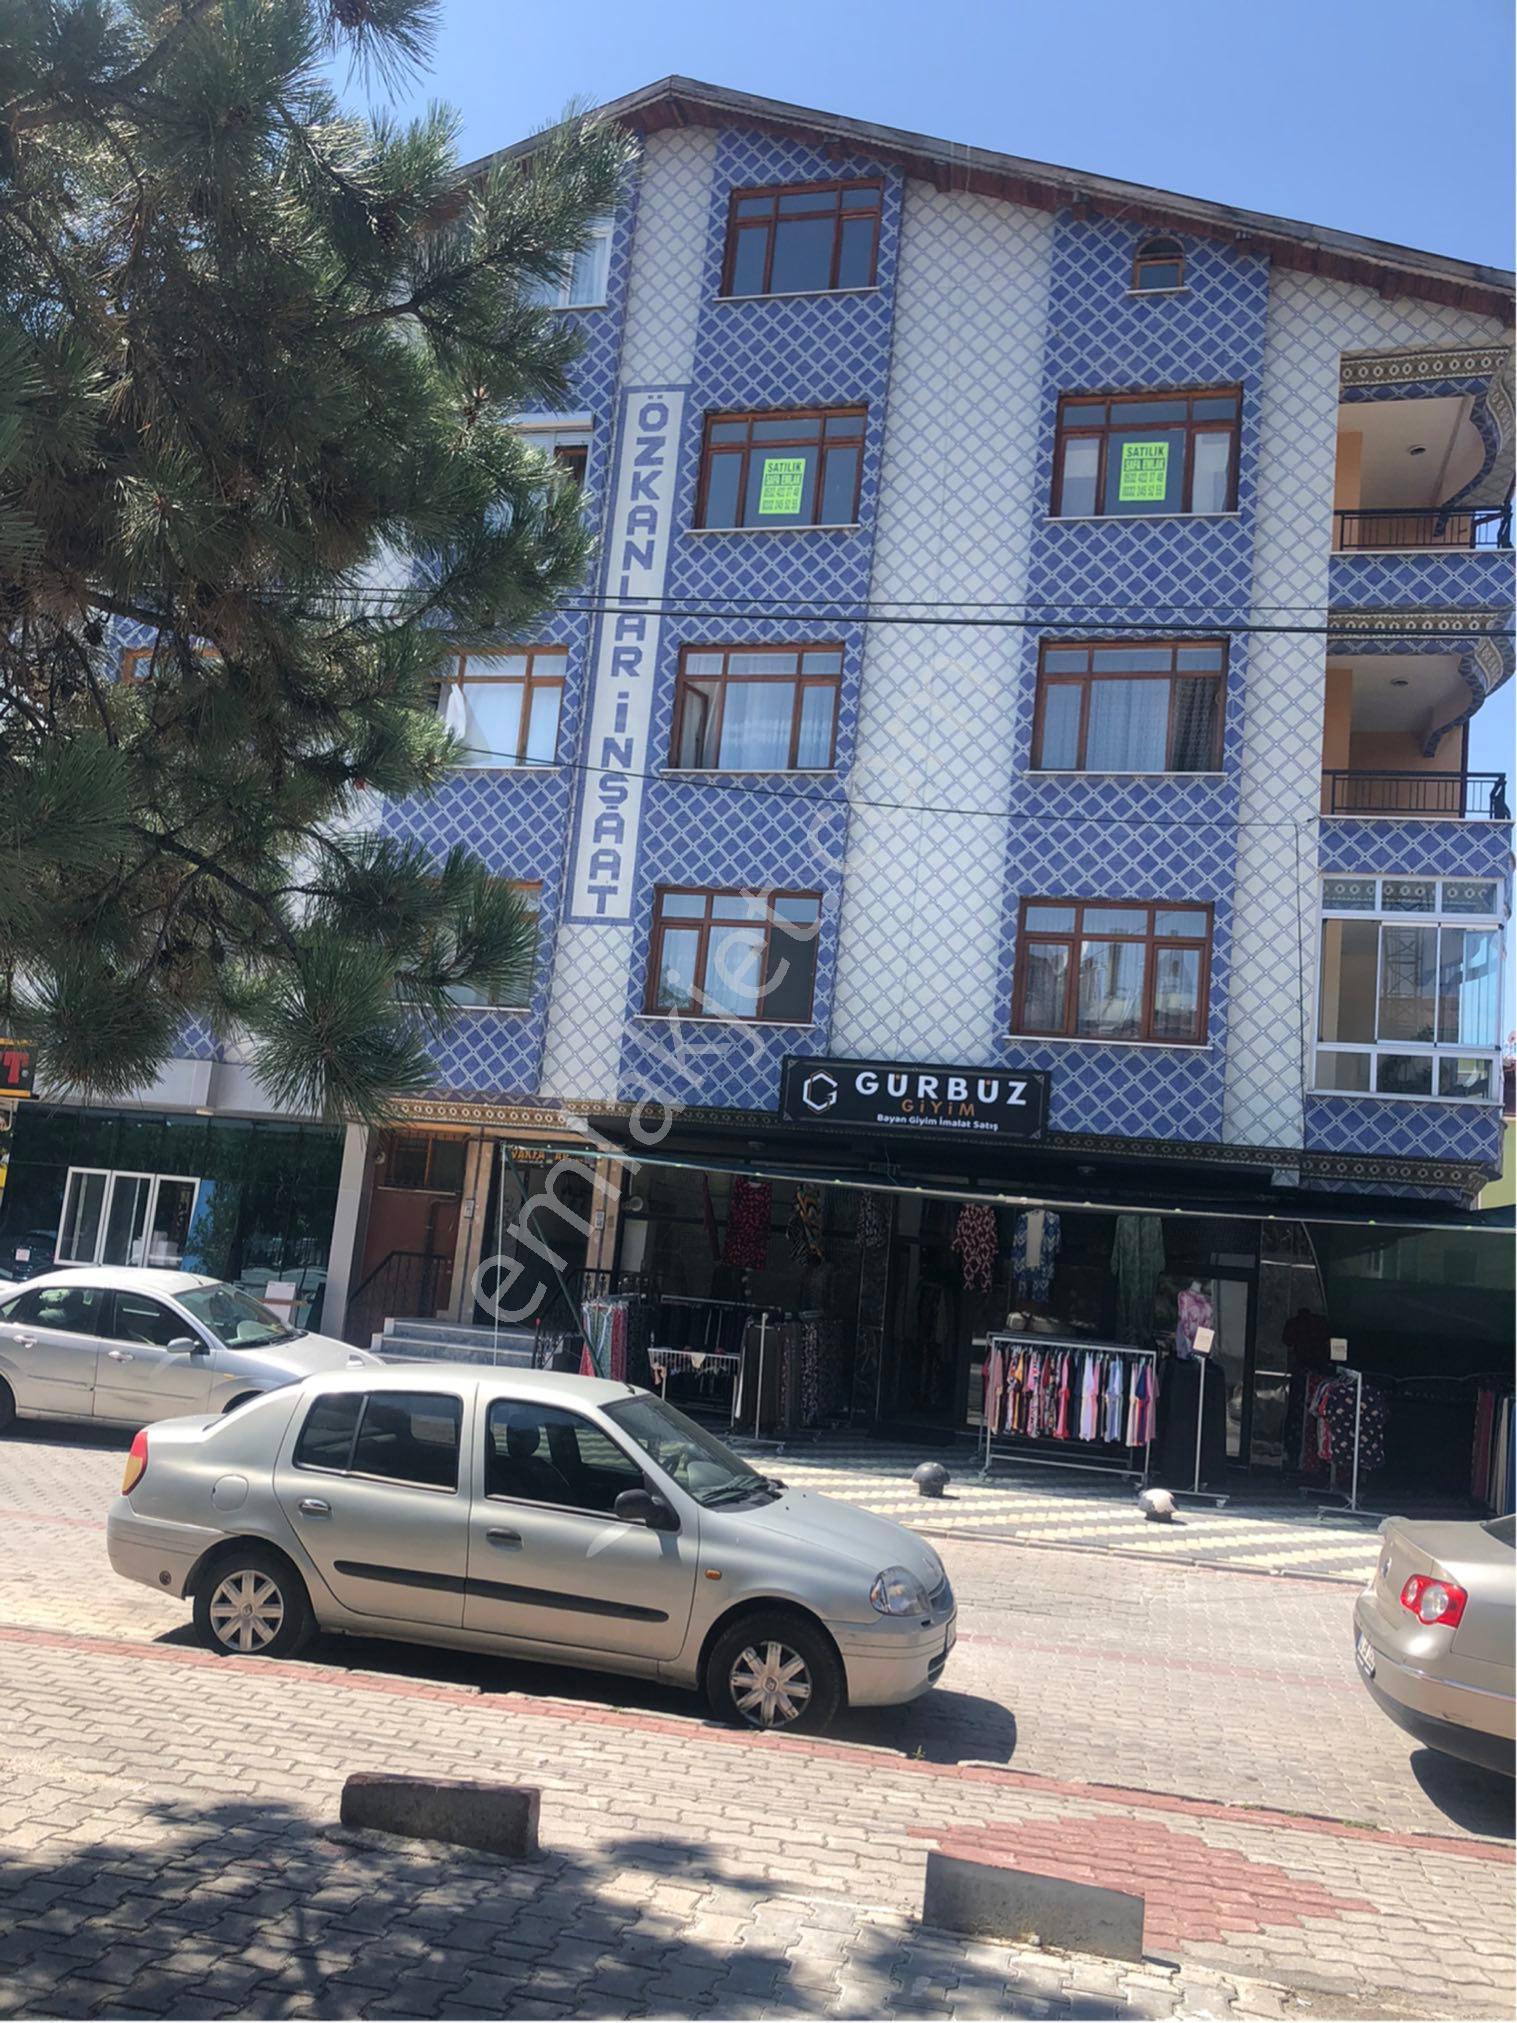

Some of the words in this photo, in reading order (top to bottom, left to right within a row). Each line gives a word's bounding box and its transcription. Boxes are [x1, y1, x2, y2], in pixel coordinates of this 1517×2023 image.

[1127, 446, 1164, 457] SATILIK
[767, 462, 802, 472] SATILIK
[610, 394, 669, 677] ÖZKANLAR
[877, 1113, 907, 1125] Bayan
[908, 1115, 938, 1126] Giyim
